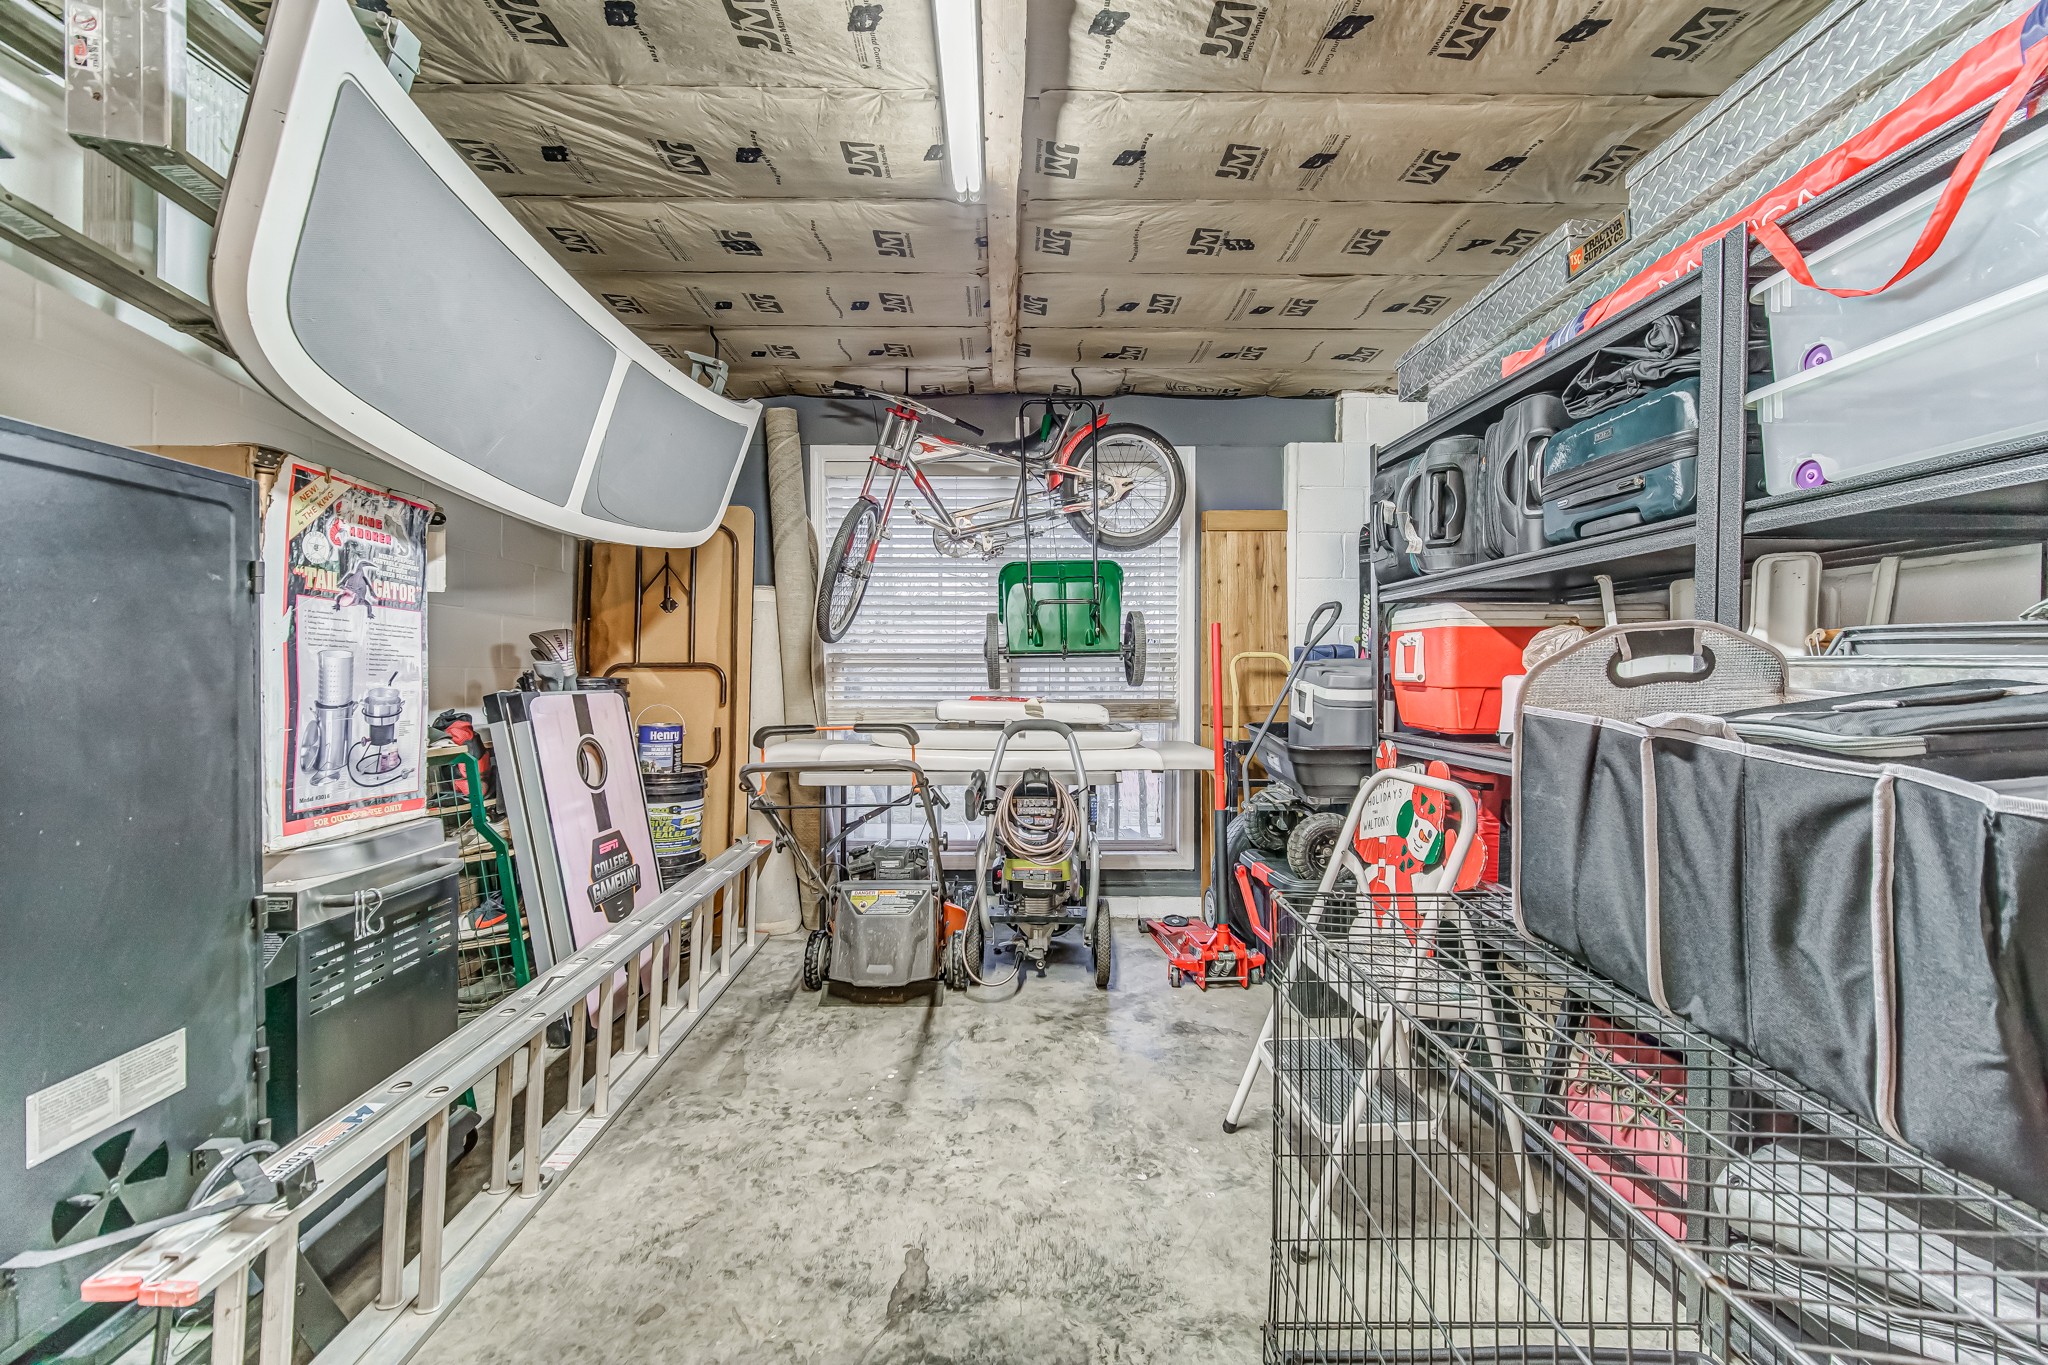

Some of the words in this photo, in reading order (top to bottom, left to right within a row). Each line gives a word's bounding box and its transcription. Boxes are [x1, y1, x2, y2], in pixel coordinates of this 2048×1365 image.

[1450, 1, 1470, 28] Johns
[1200, 1, 1257, 58] JM
[1240, 40, 1253, 62] Johns
[1250, 6, 1269, 42] Manville
[1427, 25, 1454, 56] Manville
[1436, 3, 1511, 61] JM
[1651, 7, 1740, 60] JM
[657, 139, 712, 175] JM
[840, 140, 882, 178] JM
[1044, 140, 1080, 180] JM
[1215, 144, 1262, 179] JM
[1405, 150, 1461, 185] JM
[1574, 145, 1641, 184] JM
[546, 226, 599, 254] JM
[872, 230, 907, 257] JM
[1042, 228, 1072, 256] JM
[1187, 228, 1233, 255] JM
[1347, 228, 1391, 256] JM
[1491, 228, 1541, 257] JM
[1583, 218, 1623, 254] TRACTOR
[1569, 254, 1582, 266] TSC
[1583, 236, 1613, 265] SUPPLY
[602, 293, 643, 314] JM
[750, 293, 784, 313] JM
[878, 292, 907, 313] JM
[1024, 295, 1048, 316] JM
[1147, 293, 1177, 314] JM
[1284, 298, 1319, 316] JM
[1407, 294, 1449, 315] JM
[771, 344, 801, 359] JM
[1240, 346, 1268, 360] JM
[299, 484, 318, 502] NEW!
[302, 505, 318, 520] THE
[316, 491, 334, 509] KING
[1361, 593, 1370, 648] ROSSIGNOL
[650, 731, 680, 742] Henry
[314, 817, 329, 828] FOR
[384, 804, 403, 813] ONLY
[1363, 815, 1390, 831] WALTONS
[599, 838, 618, 854] ESPN
[594, 852, 629, 878] COLLEGE
[592, 865, 637, 903] GAMEDAY
